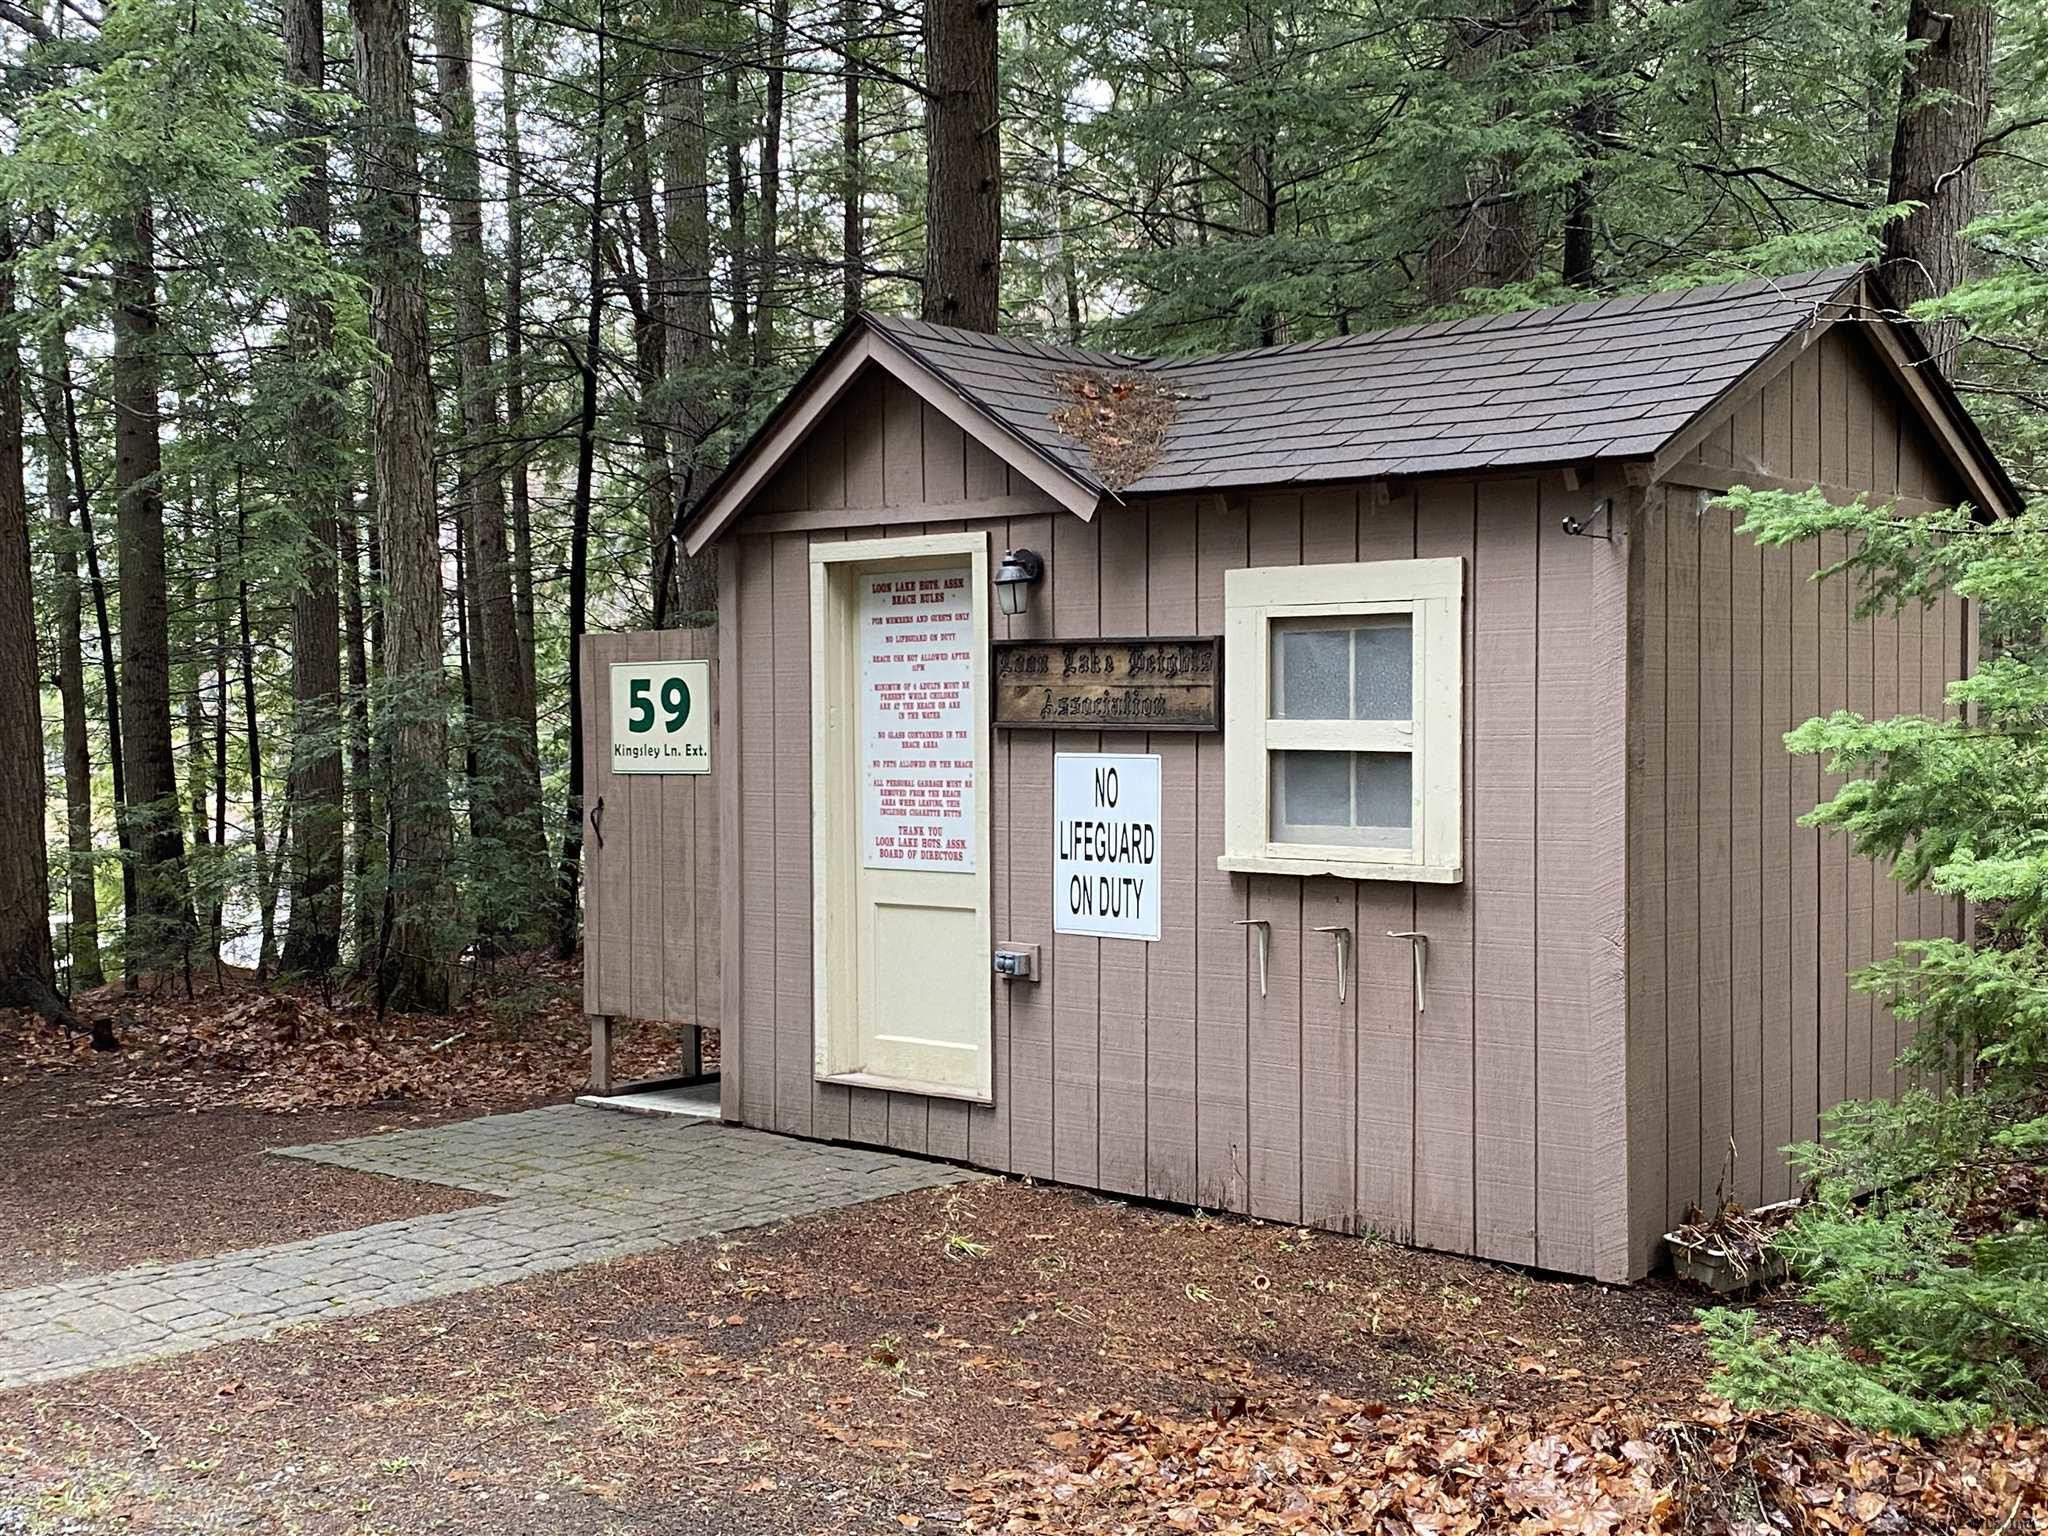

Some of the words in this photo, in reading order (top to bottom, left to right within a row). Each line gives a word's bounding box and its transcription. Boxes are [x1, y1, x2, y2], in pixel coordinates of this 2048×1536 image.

[872, 583, 891, 593] LOON
[896, 582, 916, 592] LAKE
[892, 595, 916, 605] BEACH
[920, 593, 944, 603] RULES
[886, 616, 913, 624] MEMBERS
[931, 614, 952, 622] GUESTS
[896, 634, 927, 642] LIFEGUARD
[940, 633, 956, 641] DUTY
[921, 653, 948, 661] ALLOWED
[952, 652, 970, 660] AFTER
[909, 692, 927, 700] WHILE
[629, 677, 691, 733] 59
[1041, 688, 1167, 718] Association
[922, 711, 940, 719] WATER
[615, 744, 660, 758] Kingsley
[665, 744, 681, 756] Ln.
[686, 744, 707, 756] Ext.
[873, 760, 881, 768] NO
[946, 780, 961, 788] MUST
[1095, 767, 1118, 808] NO
[899, 799, 916, 807] WHEN
[909, 809, 940, 817] CIGARETTE
[899, 826, 923, 836] THANK
[928, 827, 942, 836] YOU
[875, 837, 894, 847] LOON
[898, 838, 918, 847] LAKE
[1060, 821, 1154, 864] LIFEGUARD
[880, 848, 903, 858] BOARD
[908, 848, 917, 859] OF
[921, 849, 963, 861] DIRECTORS
[1070, 874, 1092, 915] ON
[1100, 876, 1144, 919] DUTY
